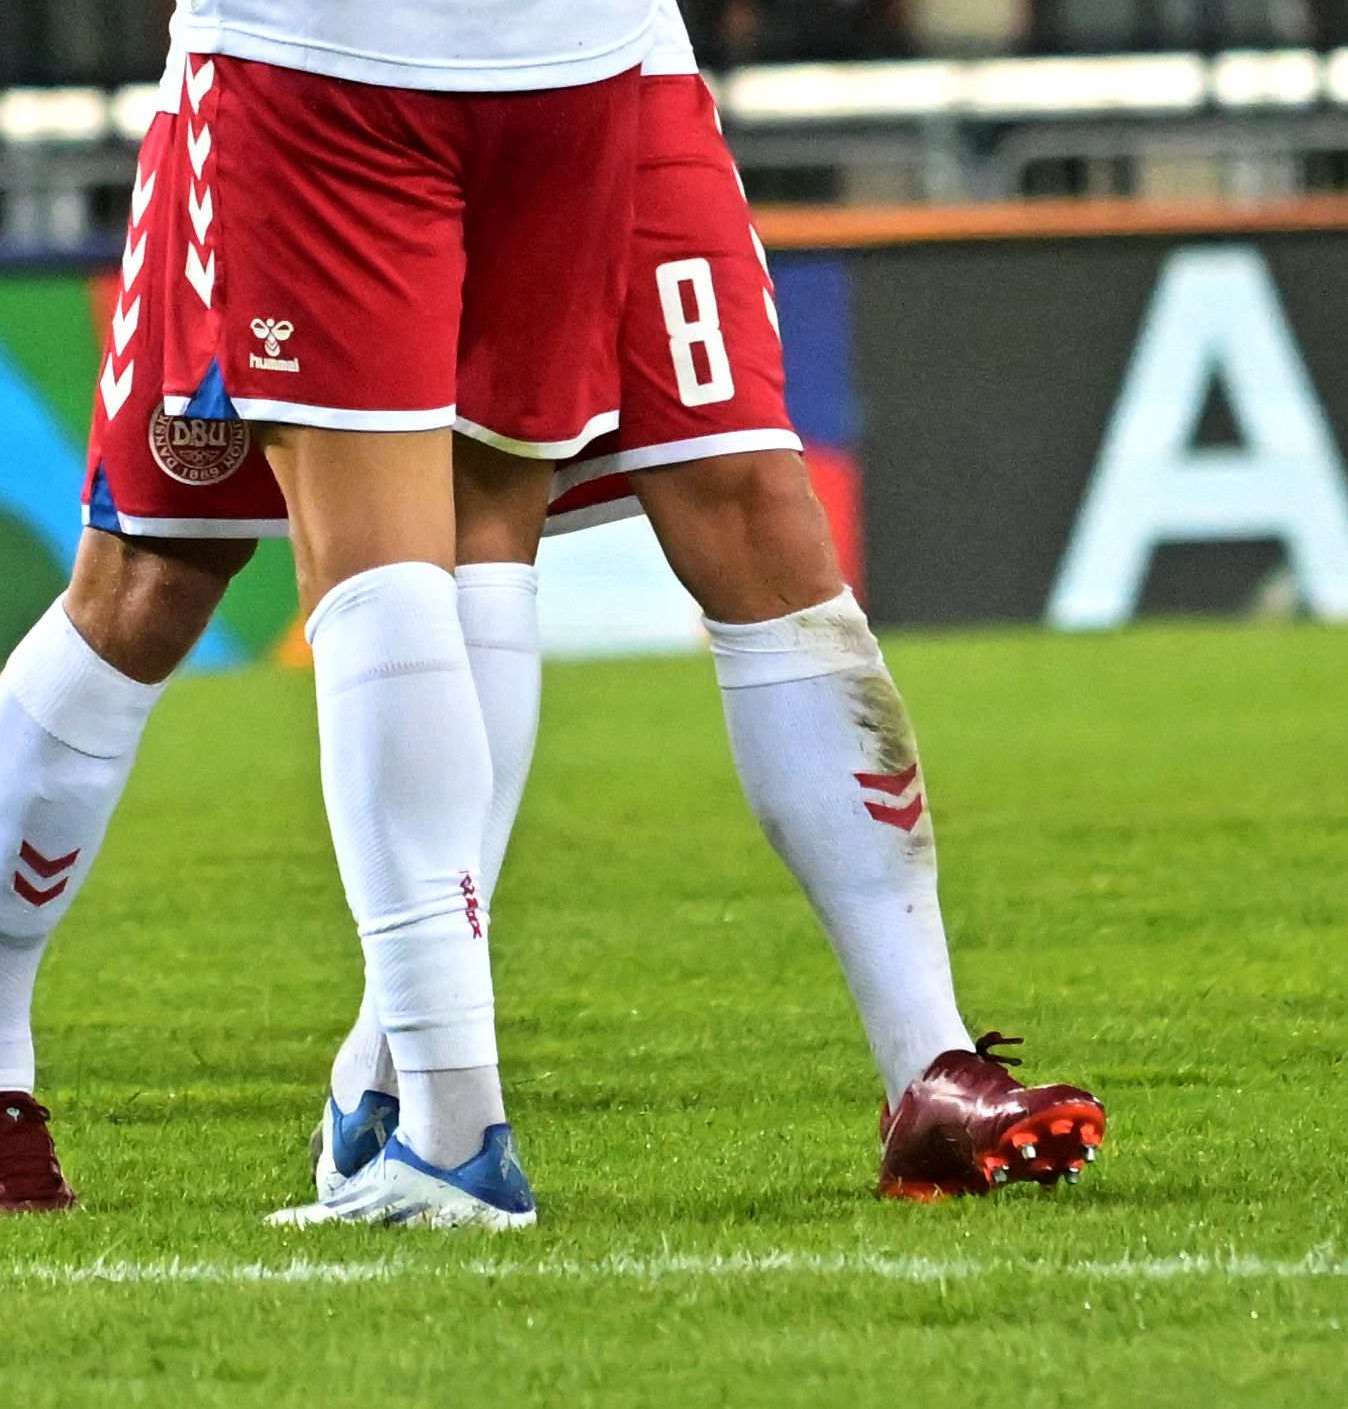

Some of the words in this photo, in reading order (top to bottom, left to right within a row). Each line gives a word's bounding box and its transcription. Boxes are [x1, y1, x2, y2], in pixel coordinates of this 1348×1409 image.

[656, 257, 735, 407] 8
[249, 352, 300, 373] hummel
[155, 413, 178, 469] DANSK
[172, 419, 227, 447] DBU
[1044, 241, 1348, 629] A
